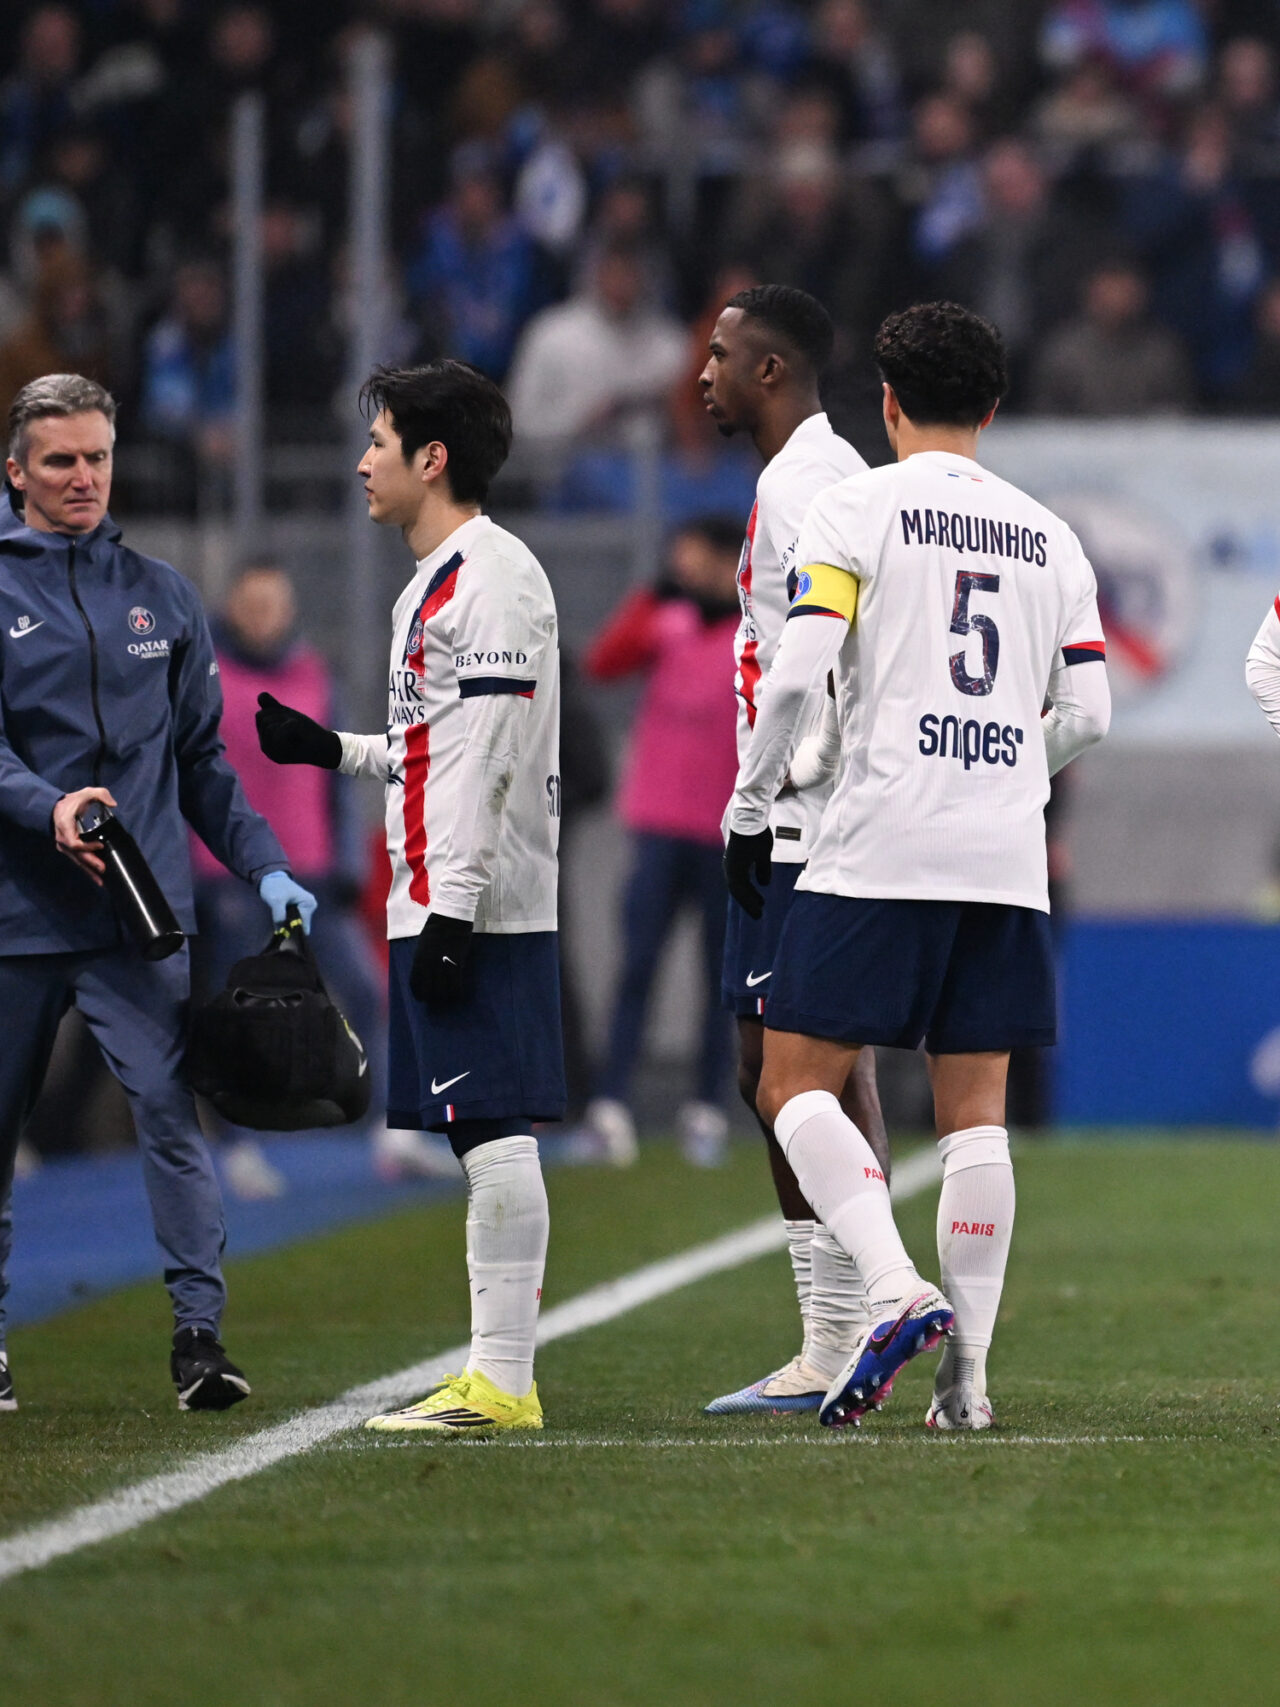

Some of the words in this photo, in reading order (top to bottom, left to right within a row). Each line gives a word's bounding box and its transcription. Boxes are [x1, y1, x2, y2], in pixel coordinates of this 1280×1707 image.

[900, 508, 1047, 567] MARQUINHOS
[949, 570, 1000, 697] 5
[127, 639, 169, 655] QATAR
[455, 650, 527, 668] BEYOND
[951, 1221, 996, 1237] PARIS
